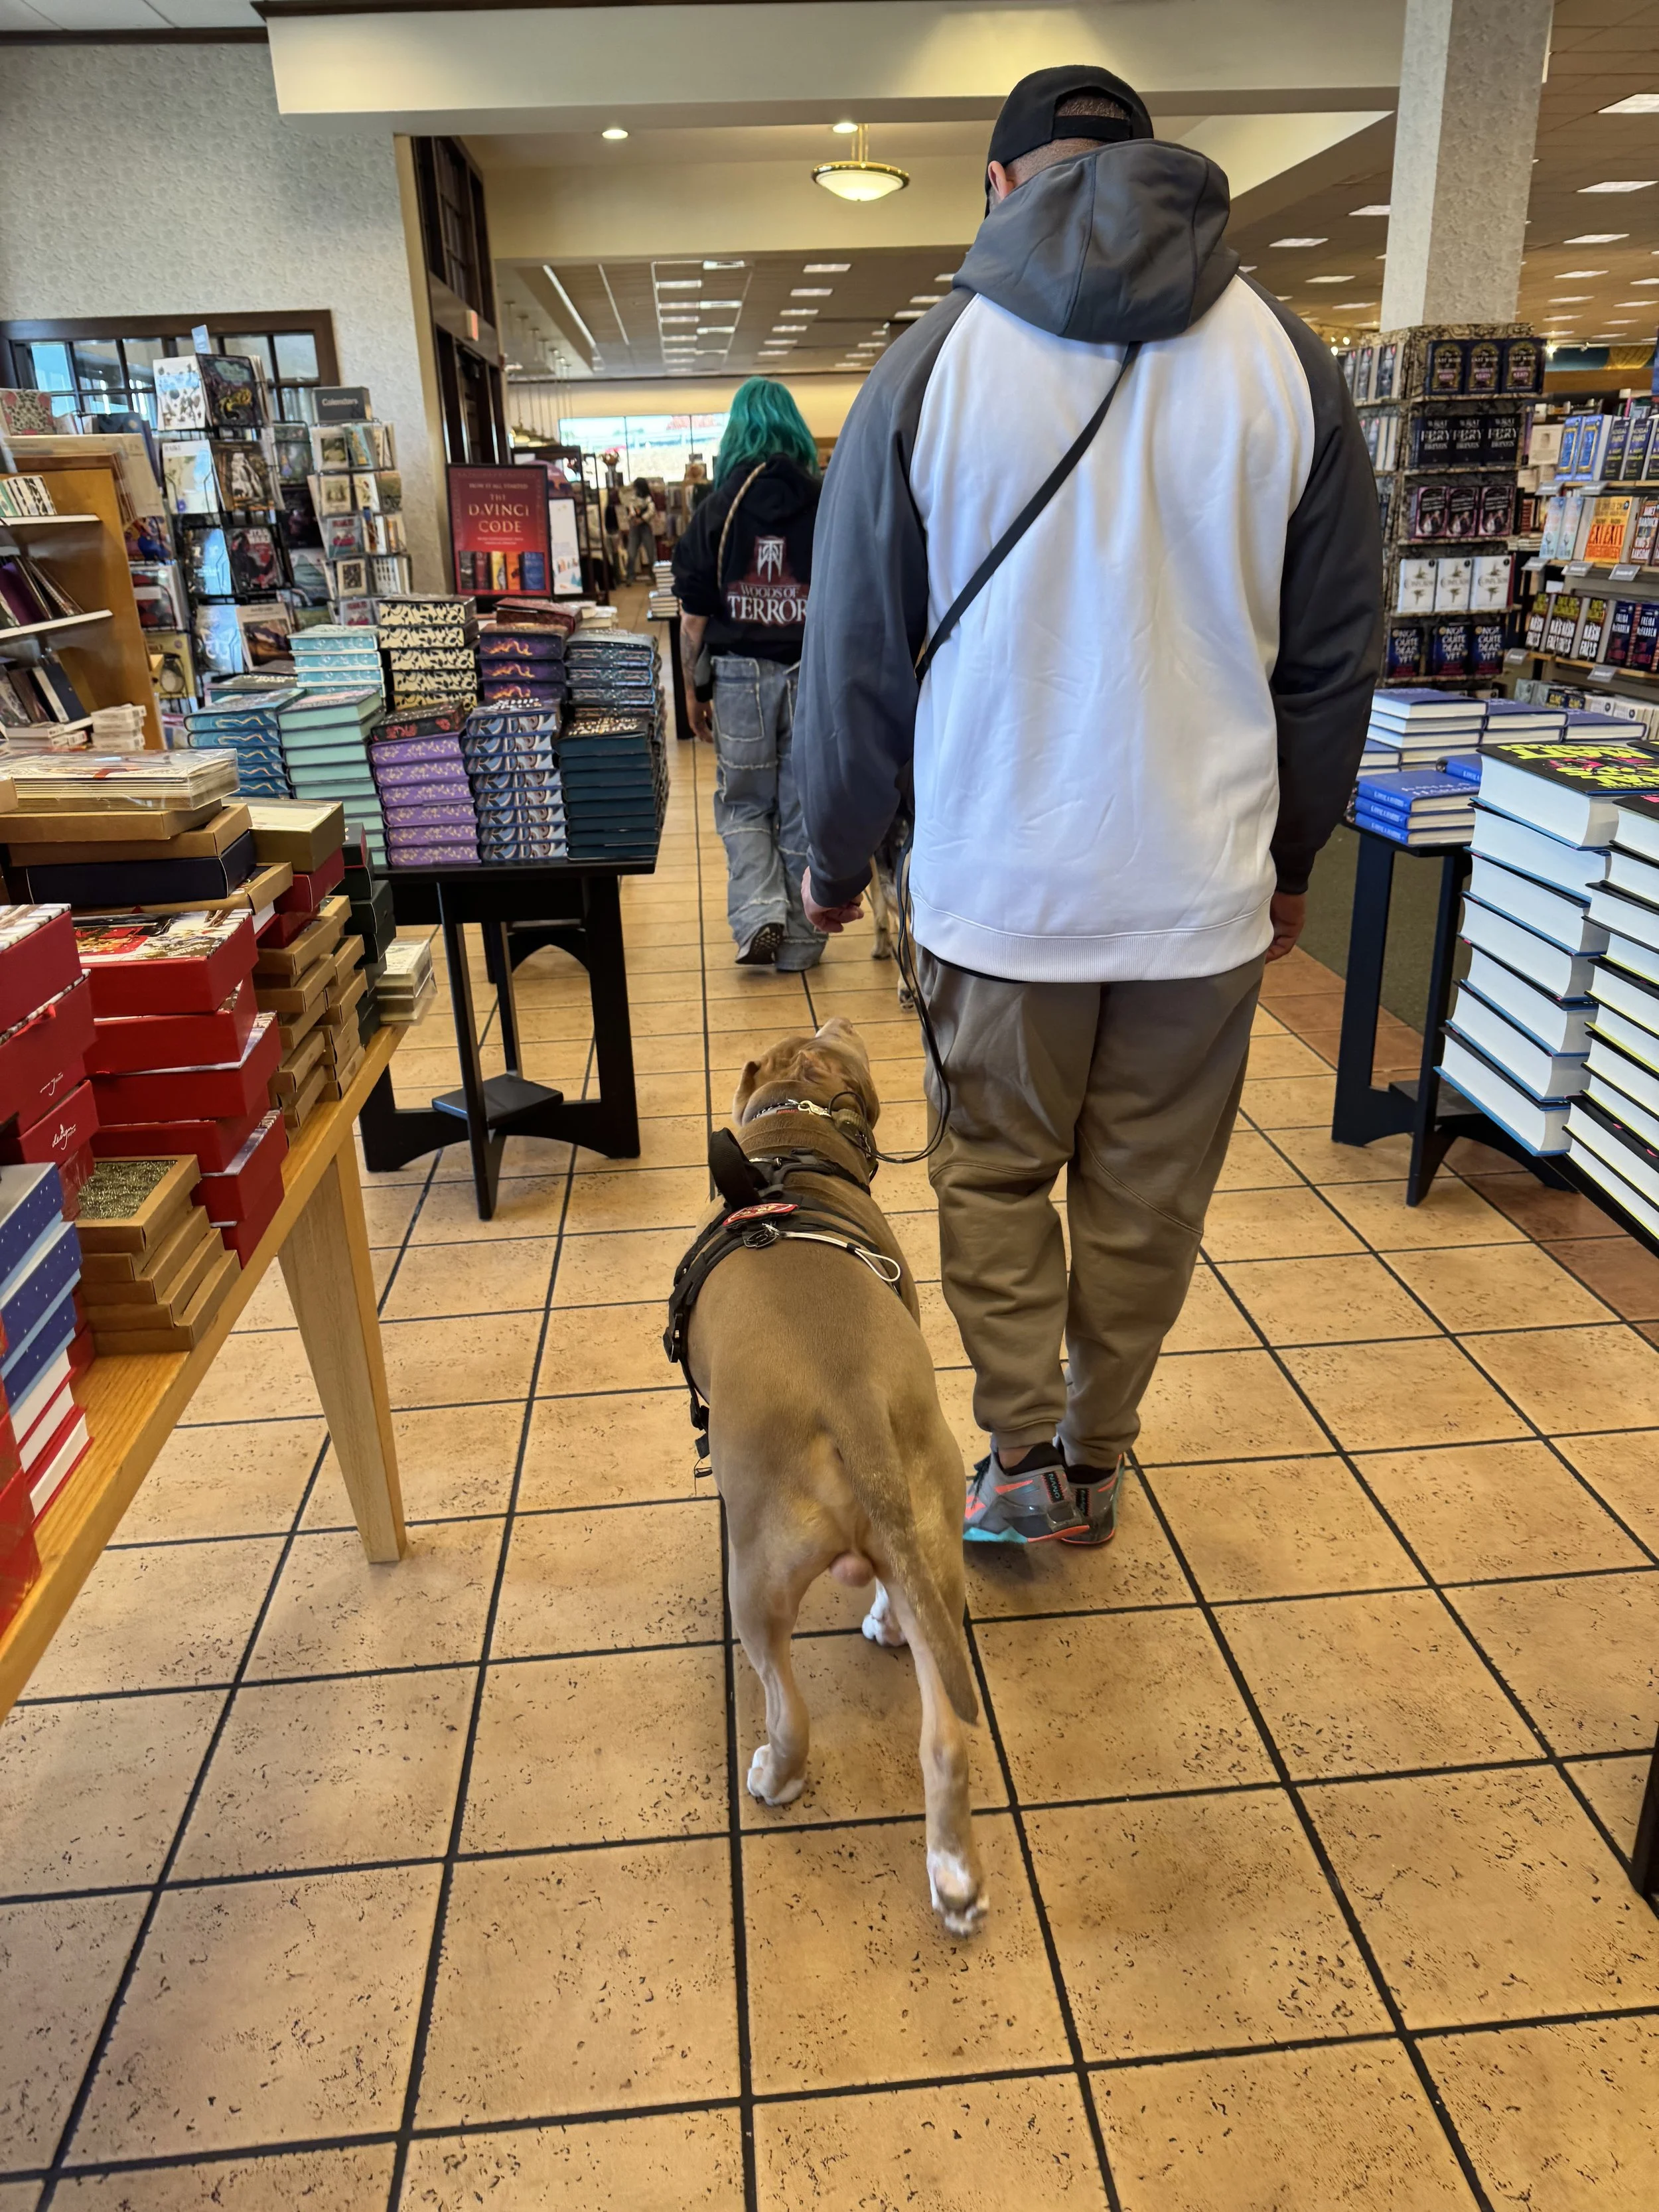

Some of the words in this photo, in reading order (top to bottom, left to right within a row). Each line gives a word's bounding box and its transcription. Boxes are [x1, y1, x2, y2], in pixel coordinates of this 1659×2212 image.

[478, 520, 522, 533] CODE
[739, 583, 783, 597] WOODS
[727, 595, 808, 624] TERROR
[1048, 1473, 1060, 1499] NANO
